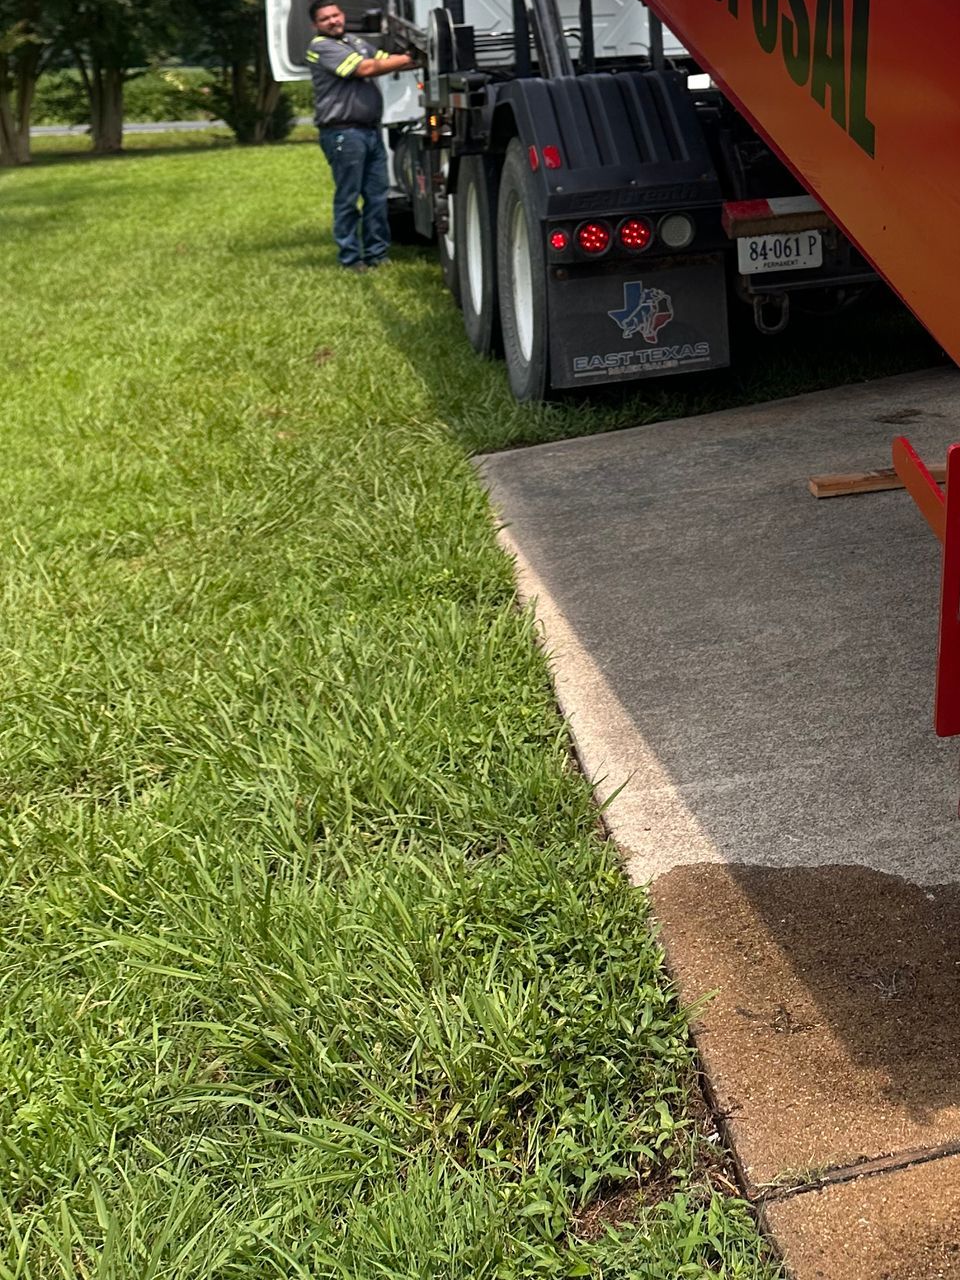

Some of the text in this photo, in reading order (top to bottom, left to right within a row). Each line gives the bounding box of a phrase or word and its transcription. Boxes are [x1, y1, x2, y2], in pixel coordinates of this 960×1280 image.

[808, 235, 817, 256] P
[763, 259, 799, 269] PERMANENT
[573, 352, 634, 371] EAST
[635, 342, 710, 364] TEXAS
